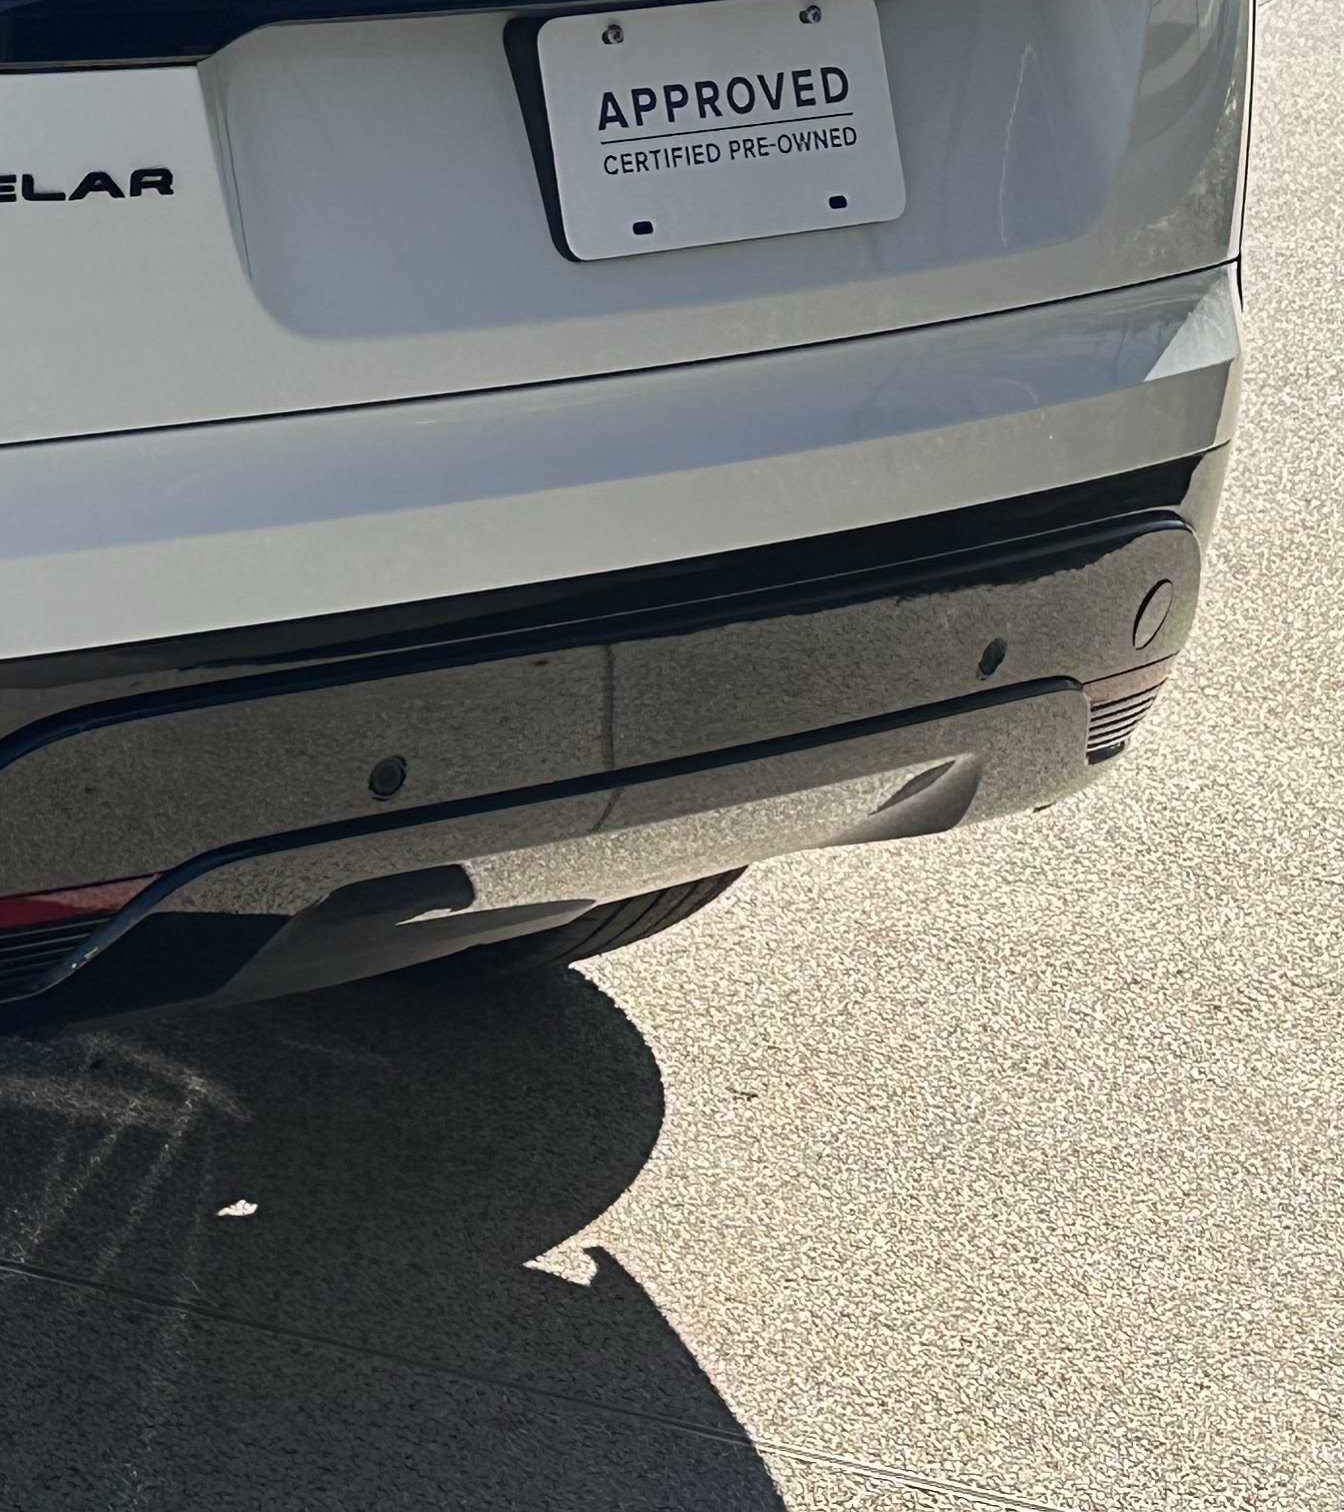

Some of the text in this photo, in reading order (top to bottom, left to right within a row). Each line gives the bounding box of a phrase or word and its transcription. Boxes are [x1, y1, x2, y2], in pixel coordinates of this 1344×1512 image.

[597, 66, 850, 132] APPROVED
[603, 126, 858, 176] CERTIFIED PRE-OWNED
